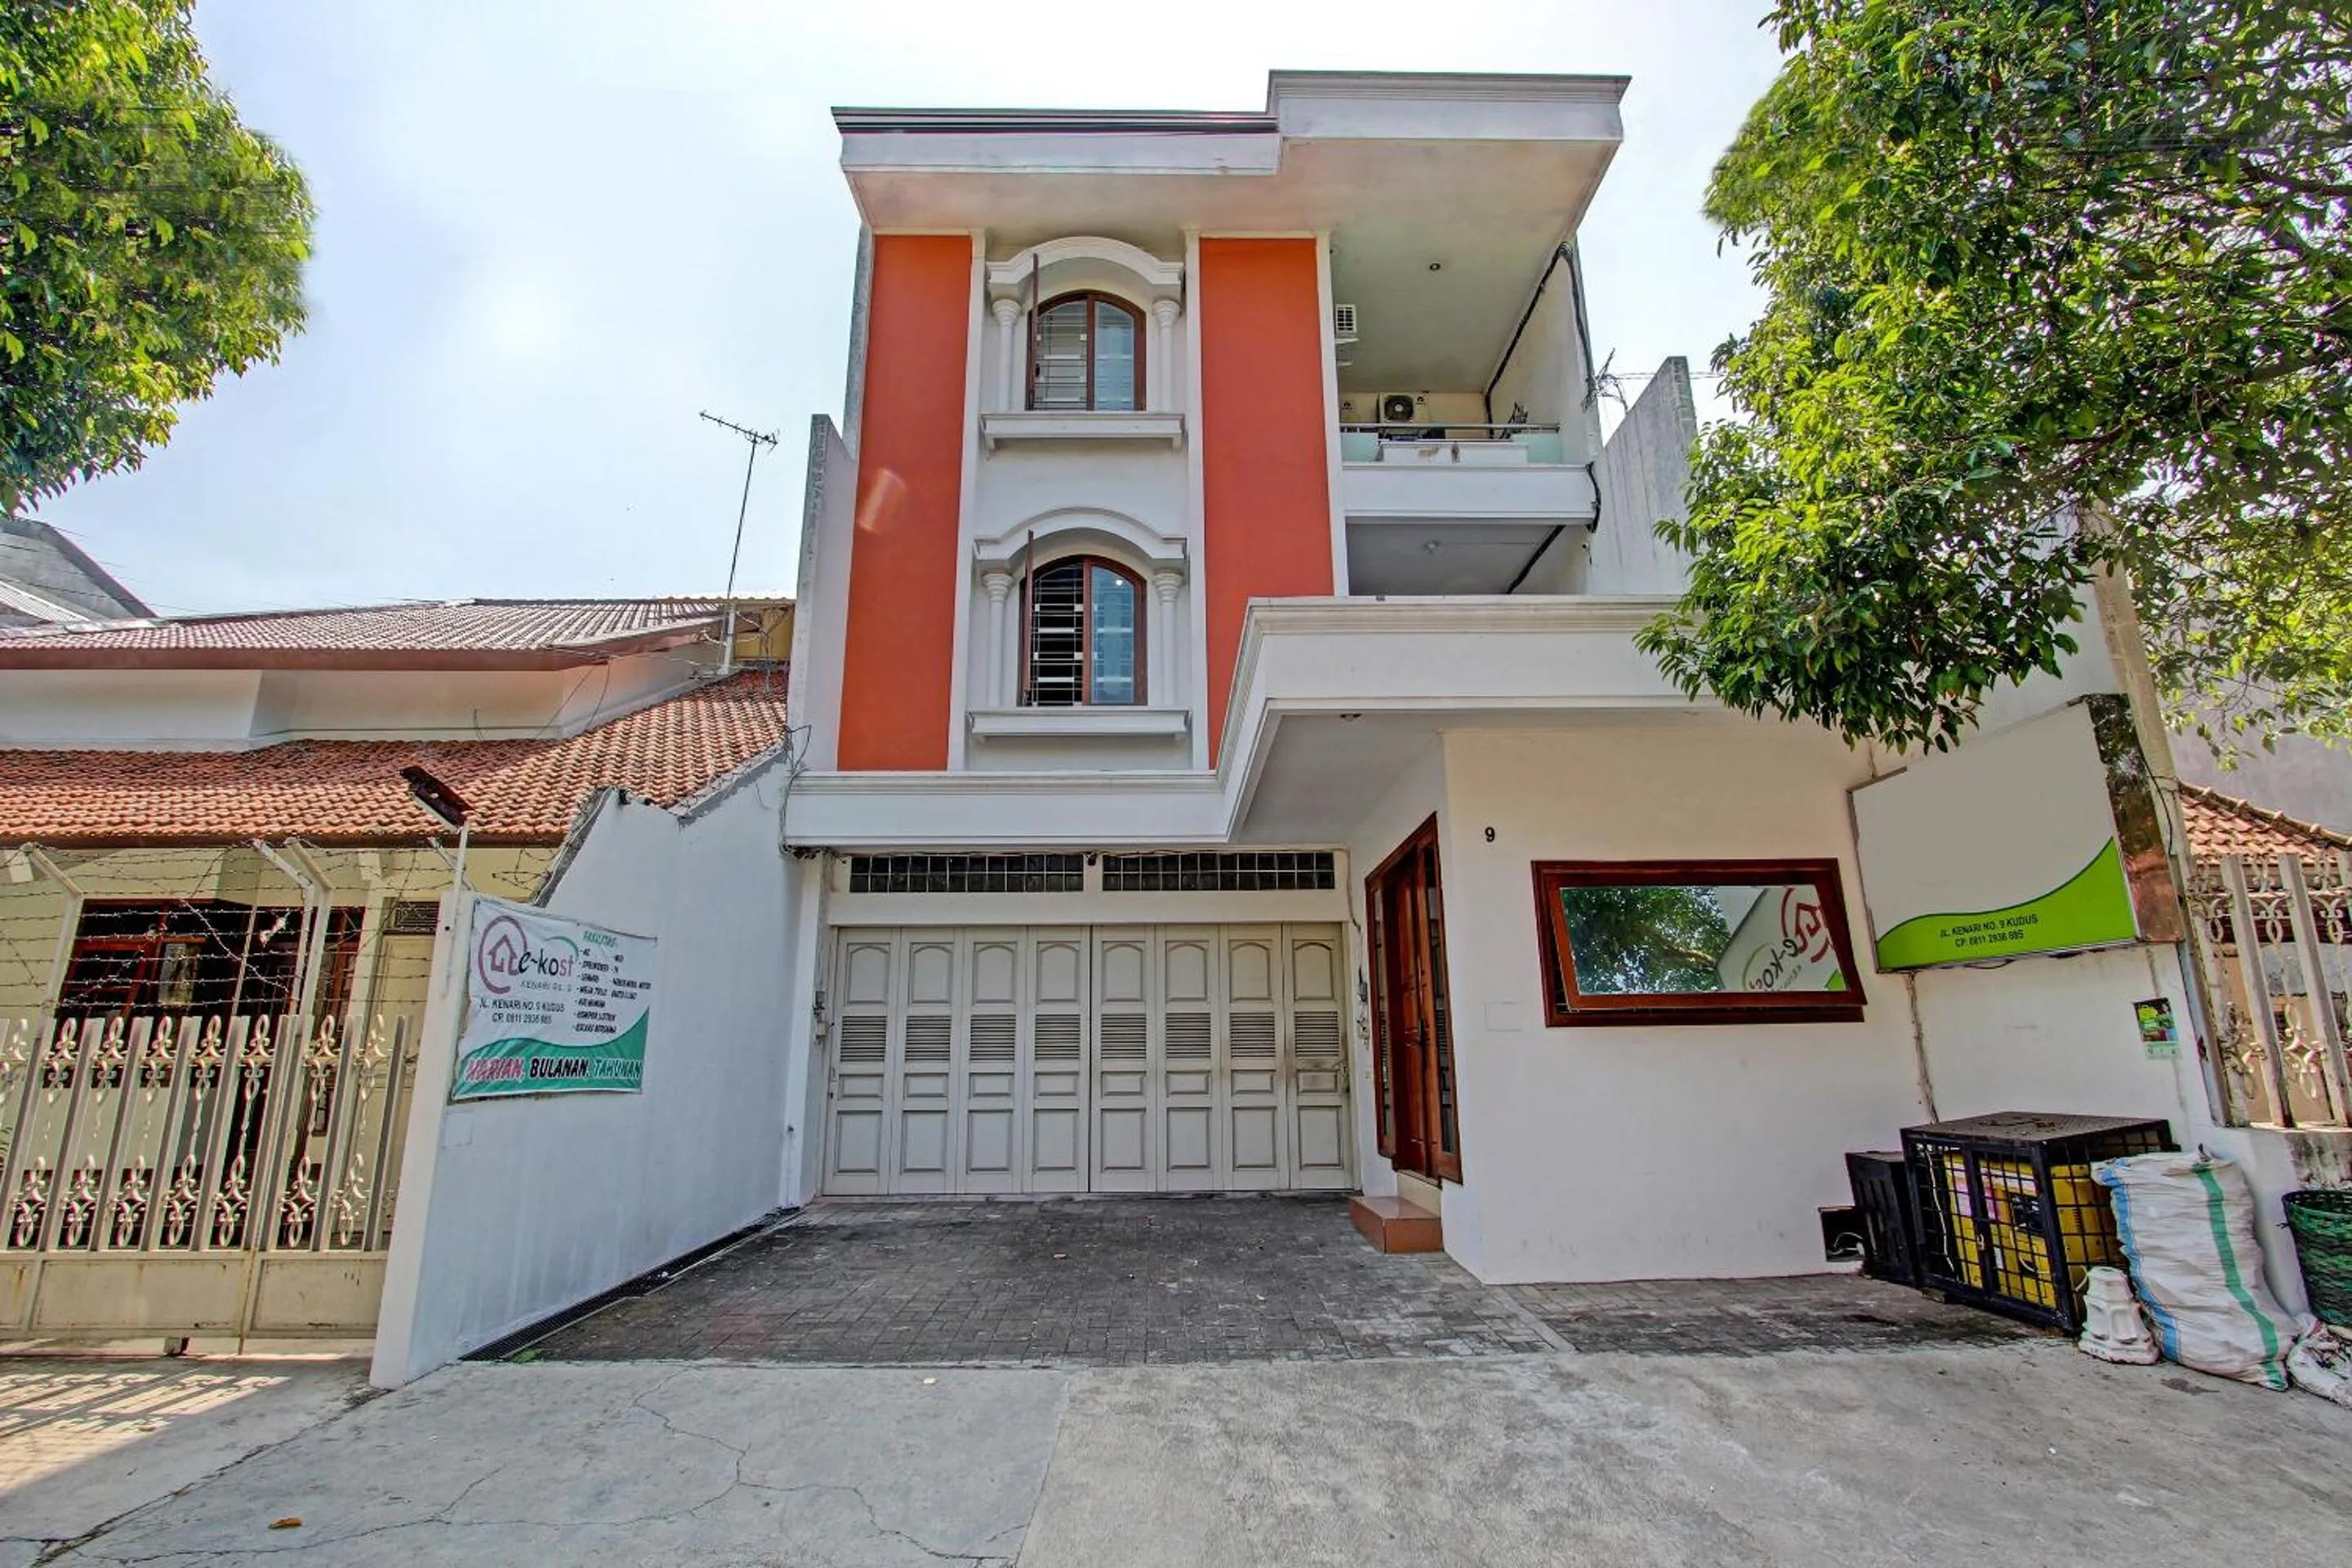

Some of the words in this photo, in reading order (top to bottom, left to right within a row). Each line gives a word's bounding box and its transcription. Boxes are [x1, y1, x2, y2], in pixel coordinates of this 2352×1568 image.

[1484, 826, 1495, 843] 9
[1953, 923, 1982, 935] KENARI
[1999, 920, 2005, 929] 9
[2007, 913, 2039, 927] KUDUS
